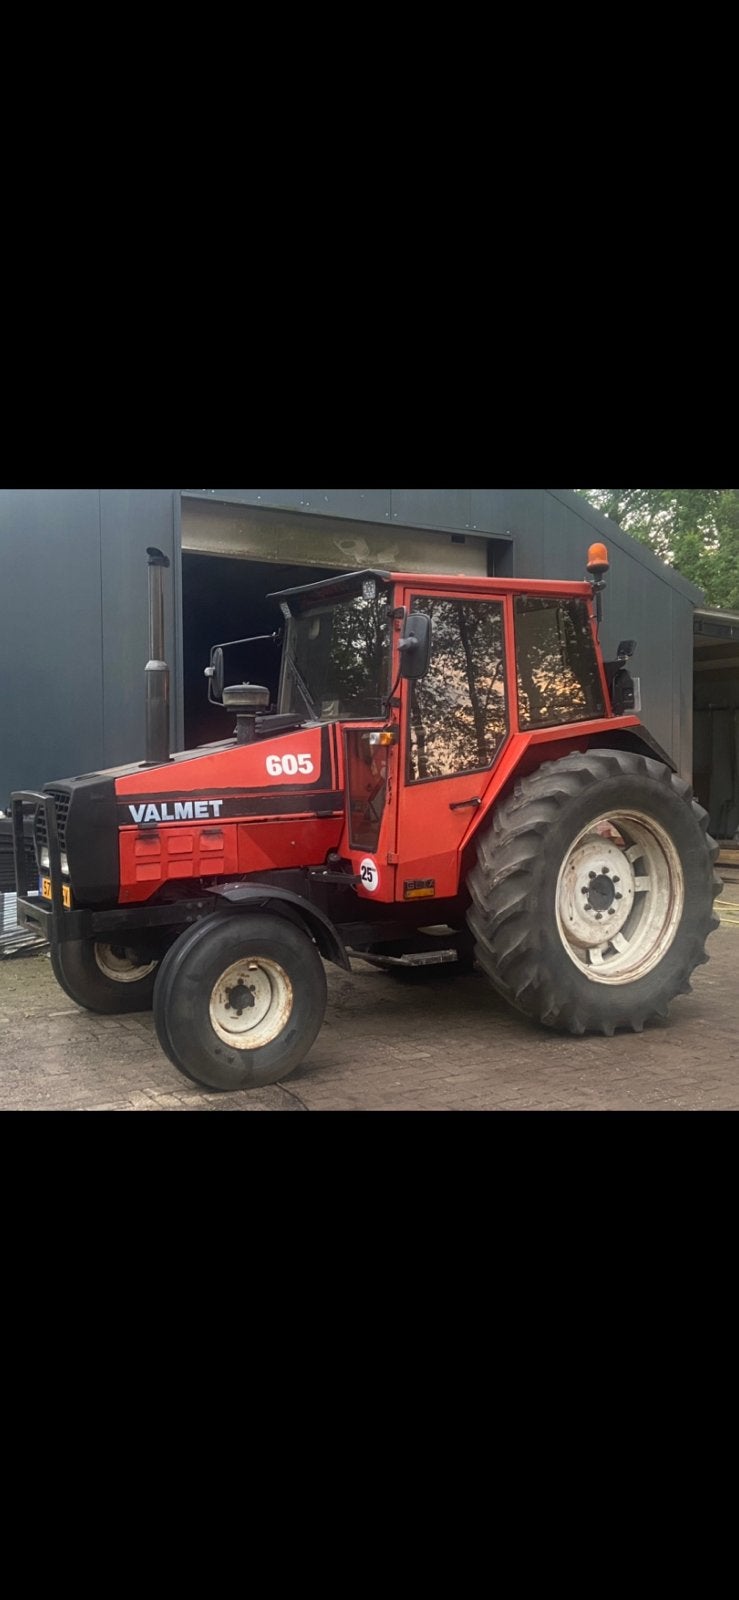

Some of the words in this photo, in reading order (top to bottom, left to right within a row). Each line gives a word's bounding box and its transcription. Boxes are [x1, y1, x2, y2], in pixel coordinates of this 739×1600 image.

[265, 753, 314, 776] 605
[128, 799, 223, 823] VALMET
[361, 865, 373, 882] 25
